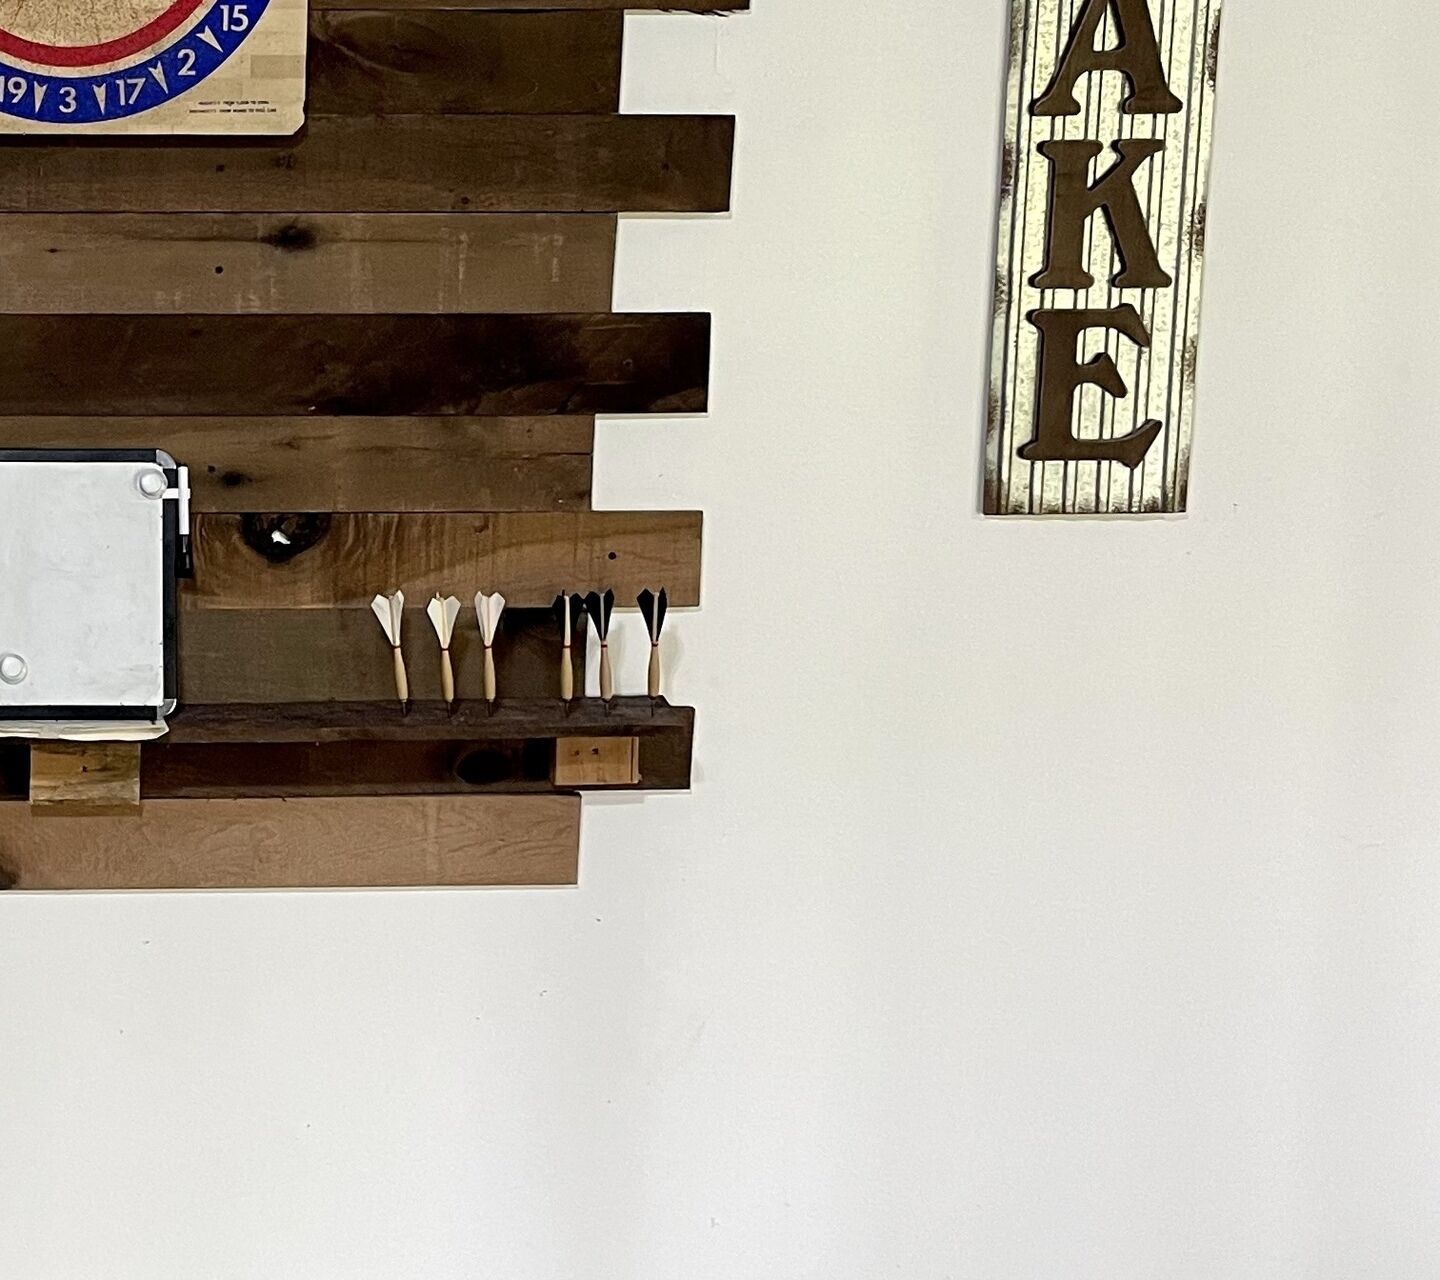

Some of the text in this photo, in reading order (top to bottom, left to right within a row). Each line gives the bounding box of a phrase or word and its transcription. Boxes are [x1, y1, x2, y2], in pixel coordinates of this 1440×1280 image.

[219, 4, 249, 32] 15
[177, 48, 196, 76] 2
[58, 86, 77, 113] 3
[115, 77, 146, 106] 17
